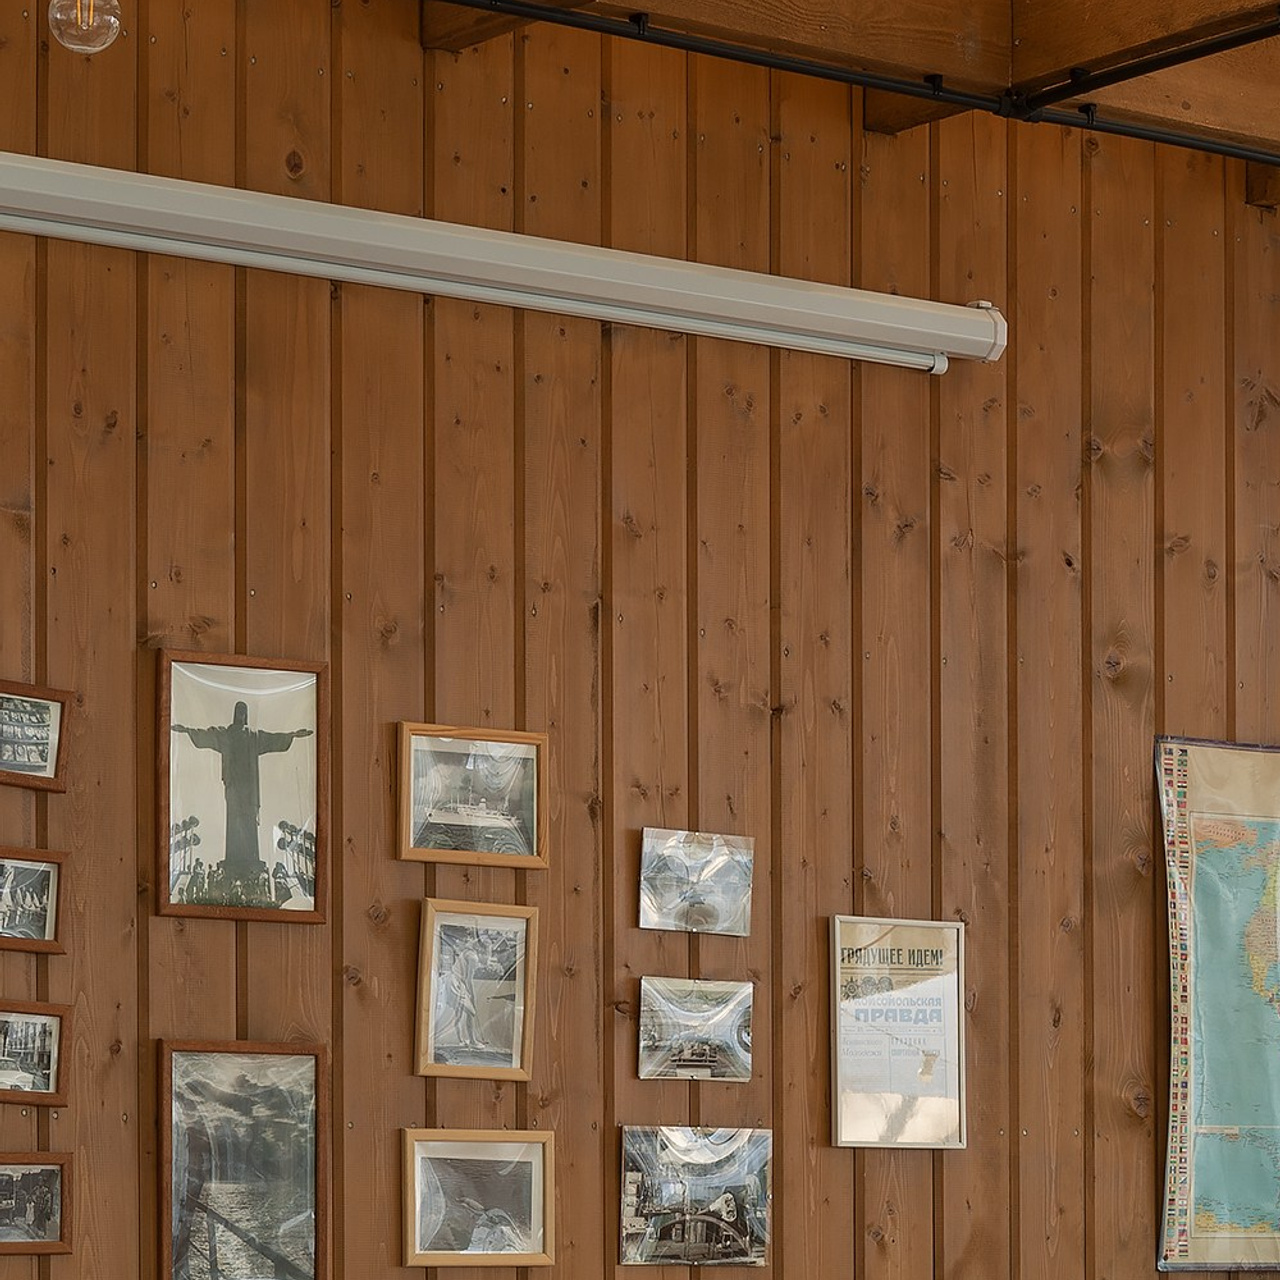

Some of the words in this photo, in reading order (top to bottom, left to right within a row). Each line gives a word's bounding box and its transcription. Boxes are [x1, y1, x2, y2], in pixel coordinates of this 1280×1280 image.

[840, 947, 904, 967] ГРЯДУЩЕЕ
[908, 949, 943, 968] ИДЕМ!
[854, 1008, 942, 1025] ПРАВДА
